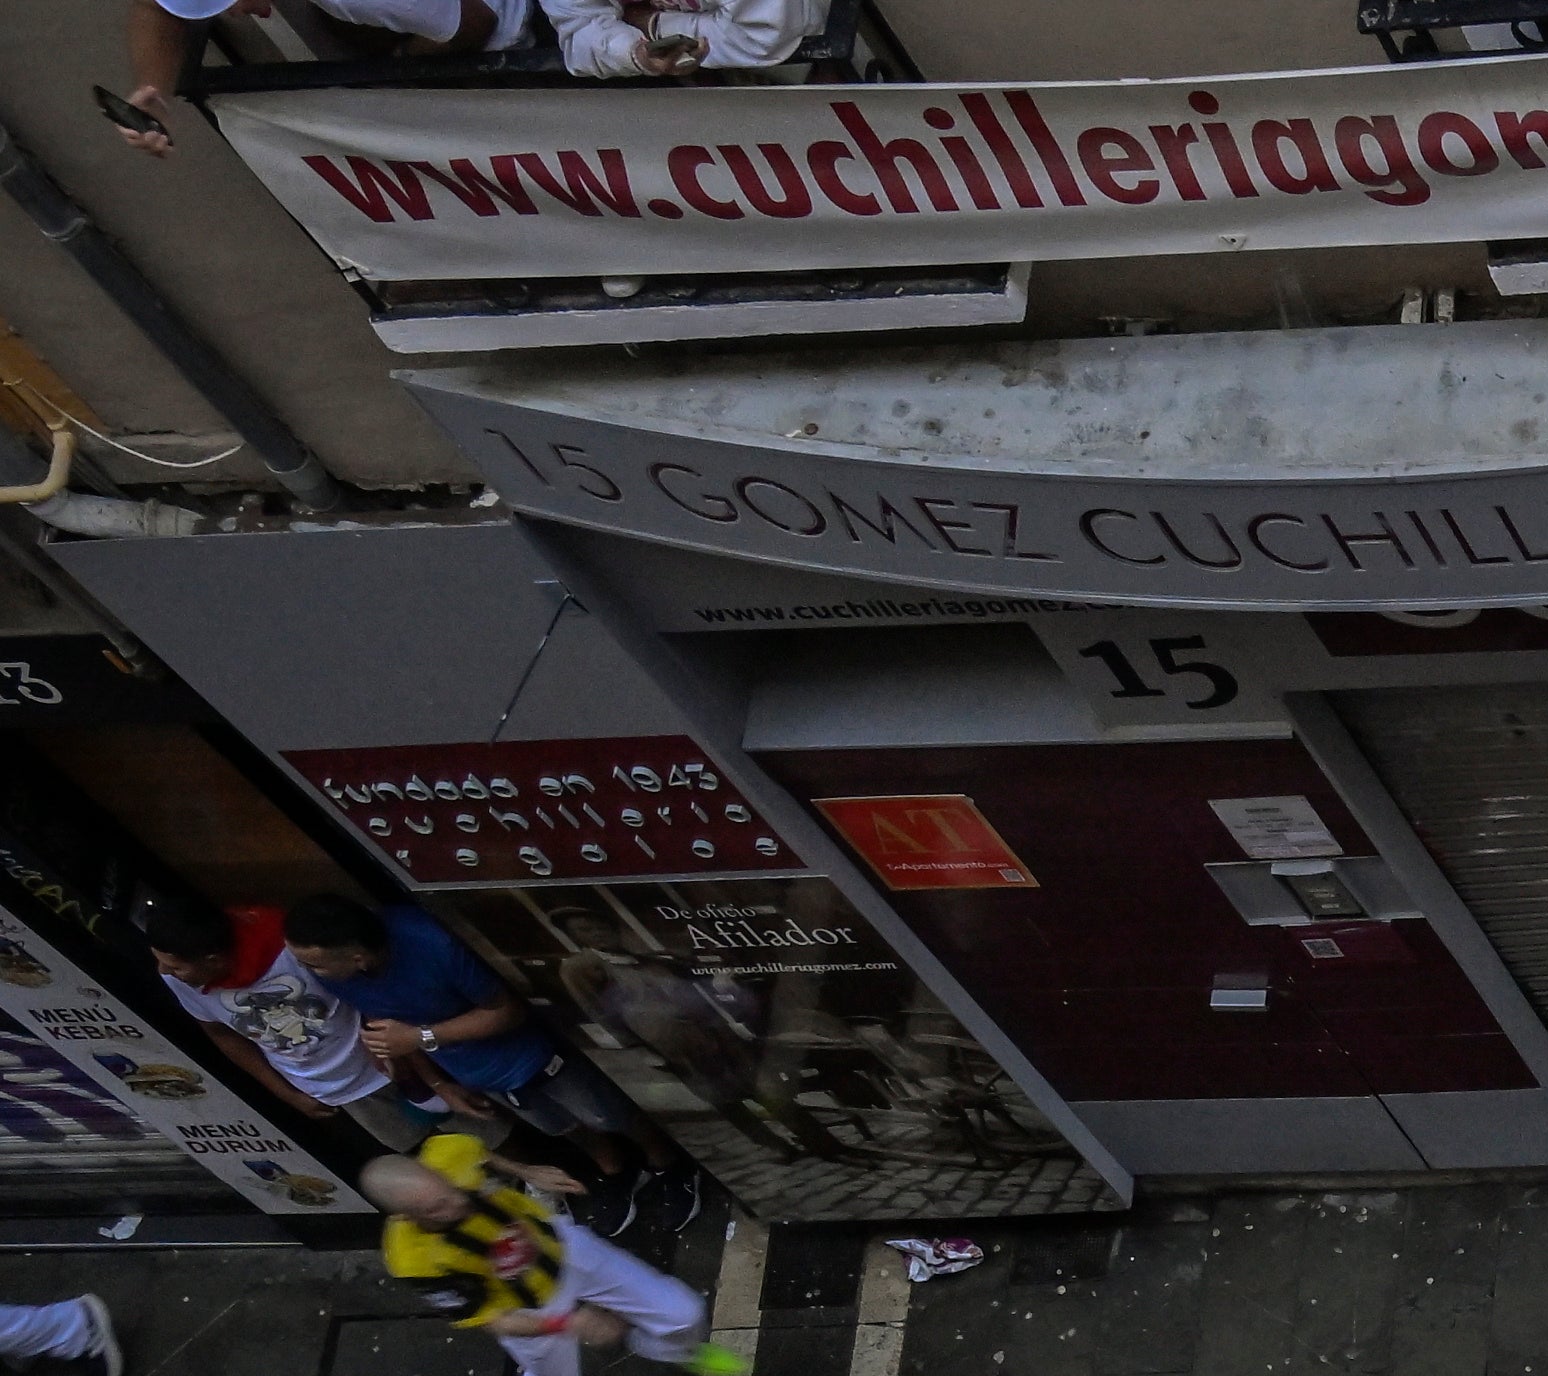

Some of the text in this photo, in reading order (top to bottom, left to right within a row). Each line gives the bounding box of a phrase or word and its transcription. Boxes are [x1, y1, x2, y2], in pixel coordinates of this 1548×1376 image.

[482, 425, 624, 505] 15
[645, 455, 1062, 565] GOMEZ
[1080, 636, 1240, 710] 15
[324, 764, 719, 810] fundada en 1943
[697, 903, 757, 919] oficio
[687, 919, 858, 951] Afilador
[691, 961, 897, 977] www.cuchilleriagomez.com
[28, 1002, 114, 1023] MENÚ
[45, 1024, 144, 1040] KEBAB
[178, 1120, 260, 1139] MENÚ
[186, 1139, 294, 1154] DURUM
